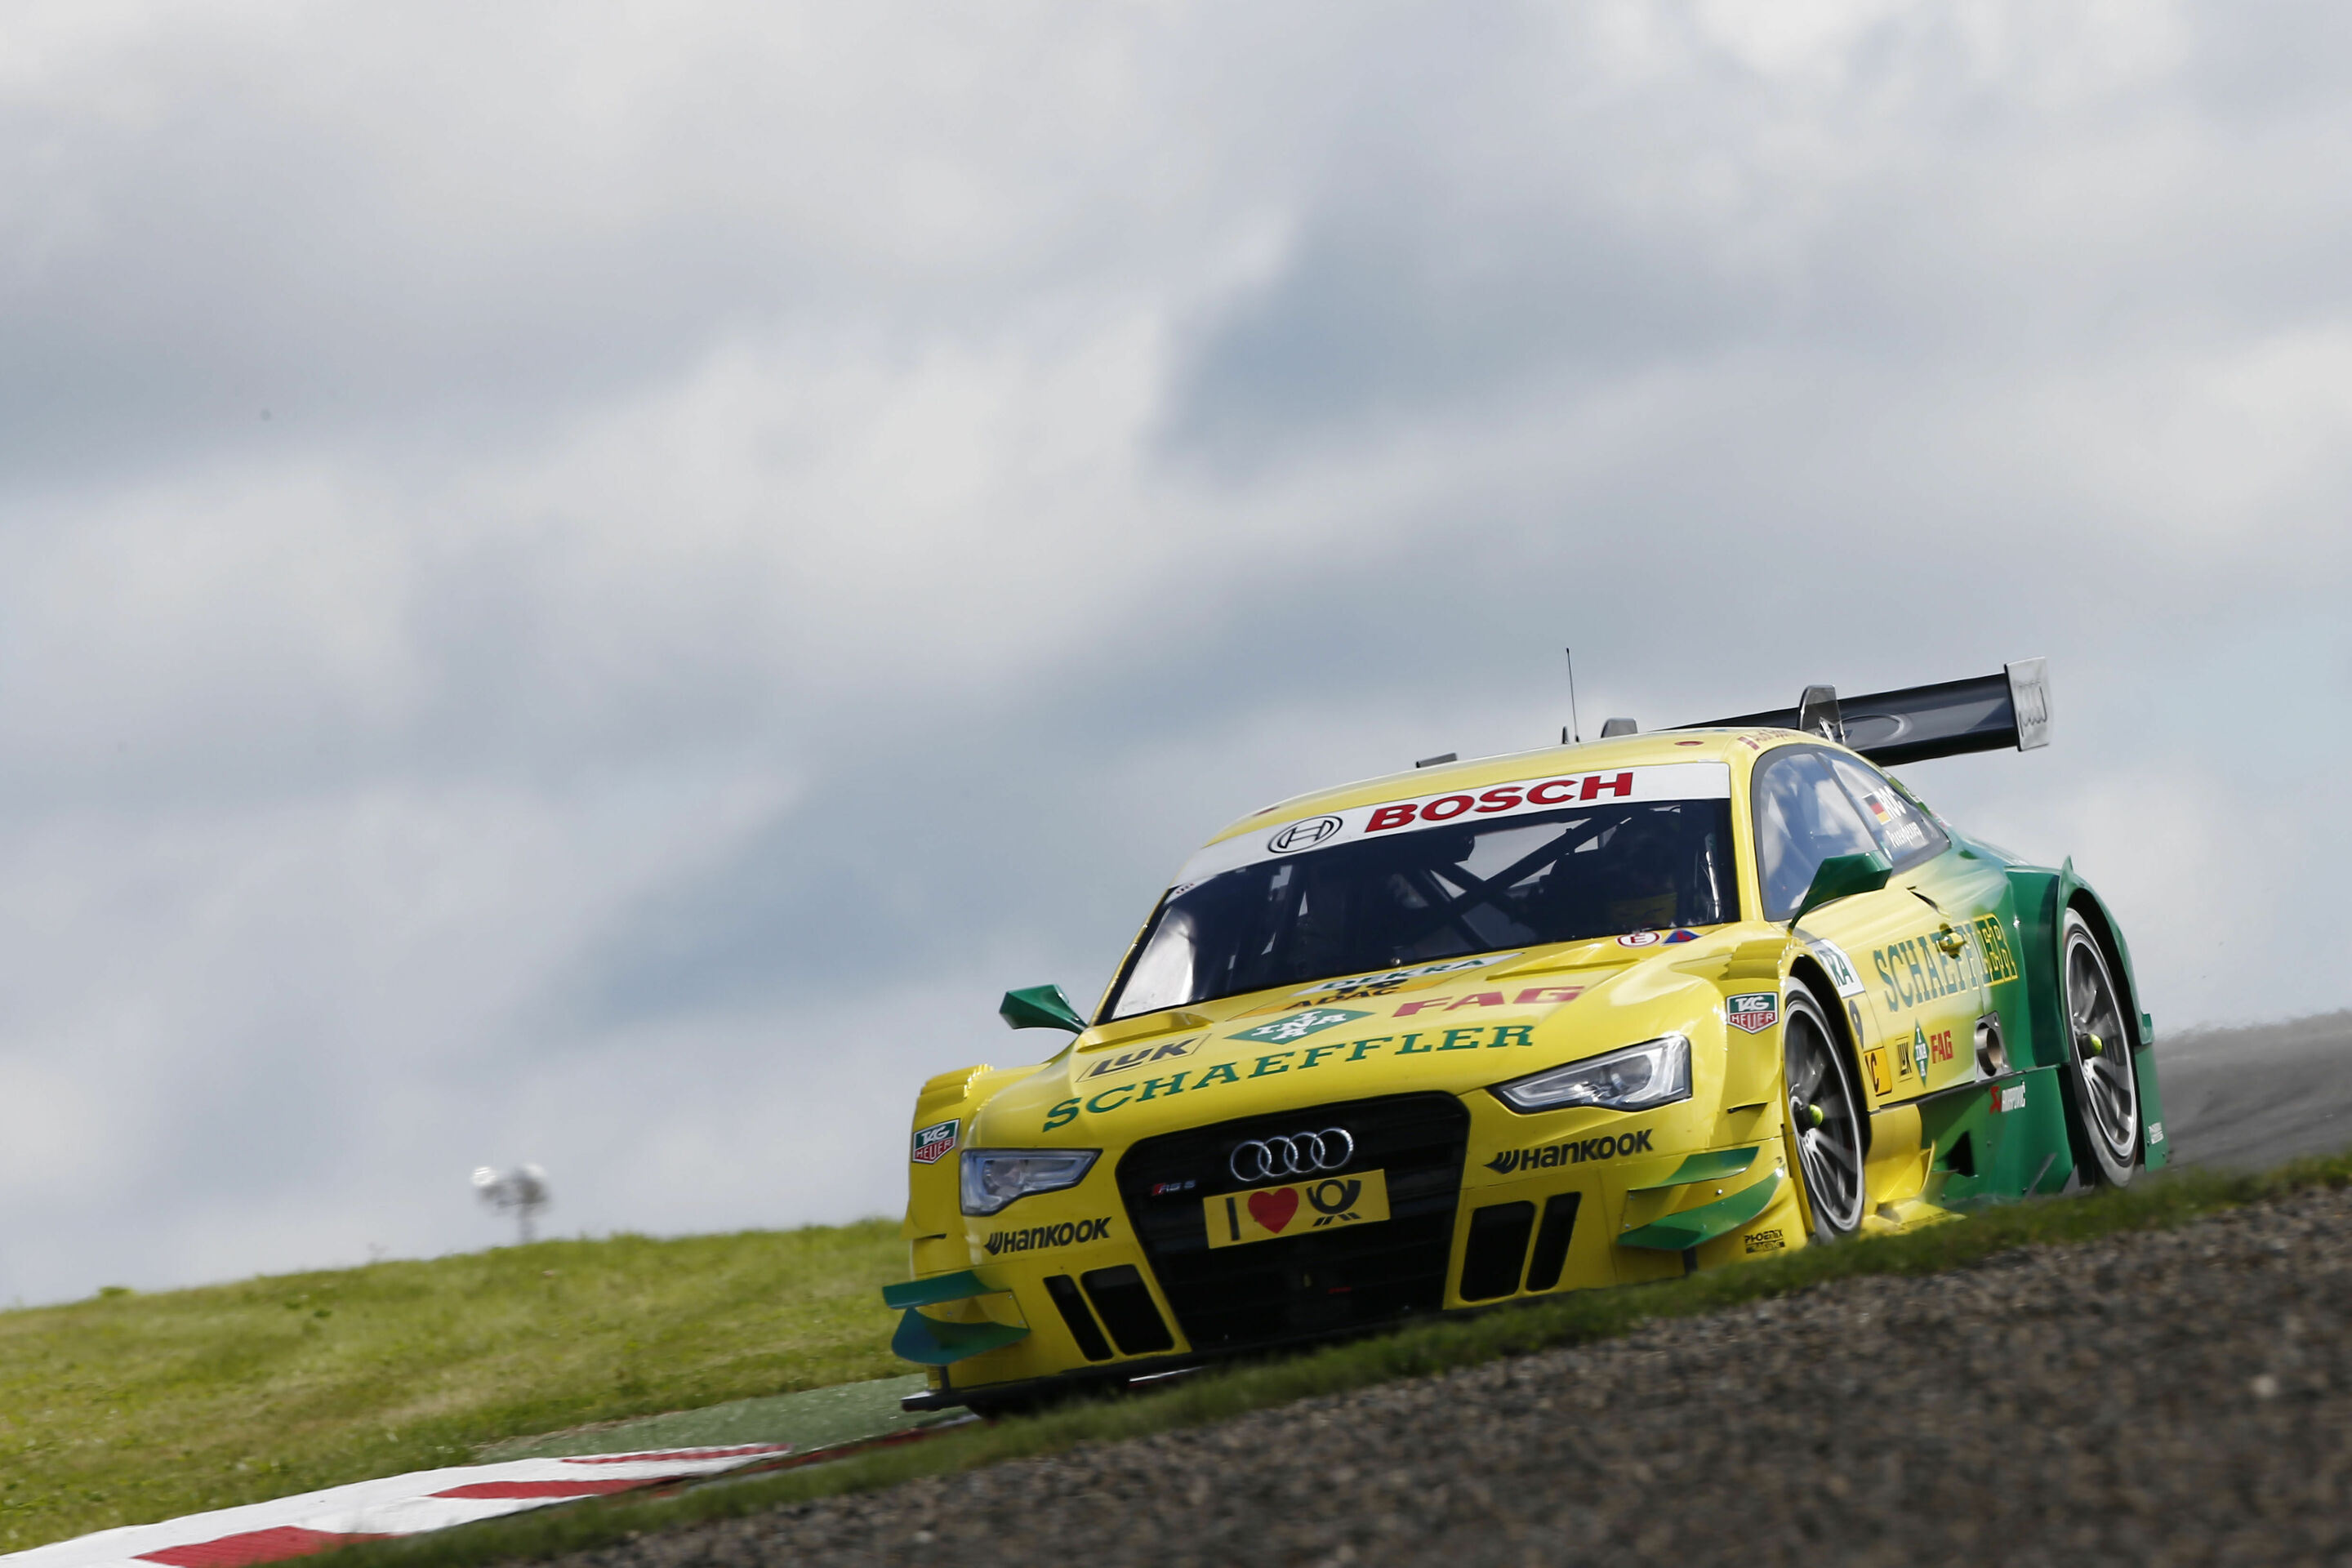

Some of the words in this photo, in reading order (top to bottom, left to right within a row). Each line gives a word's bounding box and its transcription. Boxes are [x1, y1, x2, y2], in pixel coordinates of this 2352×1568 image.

[1364, 772, 1633, 833] BOSCH
[1321, 960, 1485, 990] DEKRA
[1282, 987, 1400, 1010] ADAC
[1392, 986, 1584, 1018] FAG
[1735, 996, 1770, 1012] TAG
[1731, 1013, 1774, 1030] HEUER
[1931, 1030, 1953, 1063] FAG
[1042, 1025, 1534, 1132] SCHAEFFLER
[920, 1125, 950, 1145] TAG
[915, 1139, 951, 1160] HEUER
